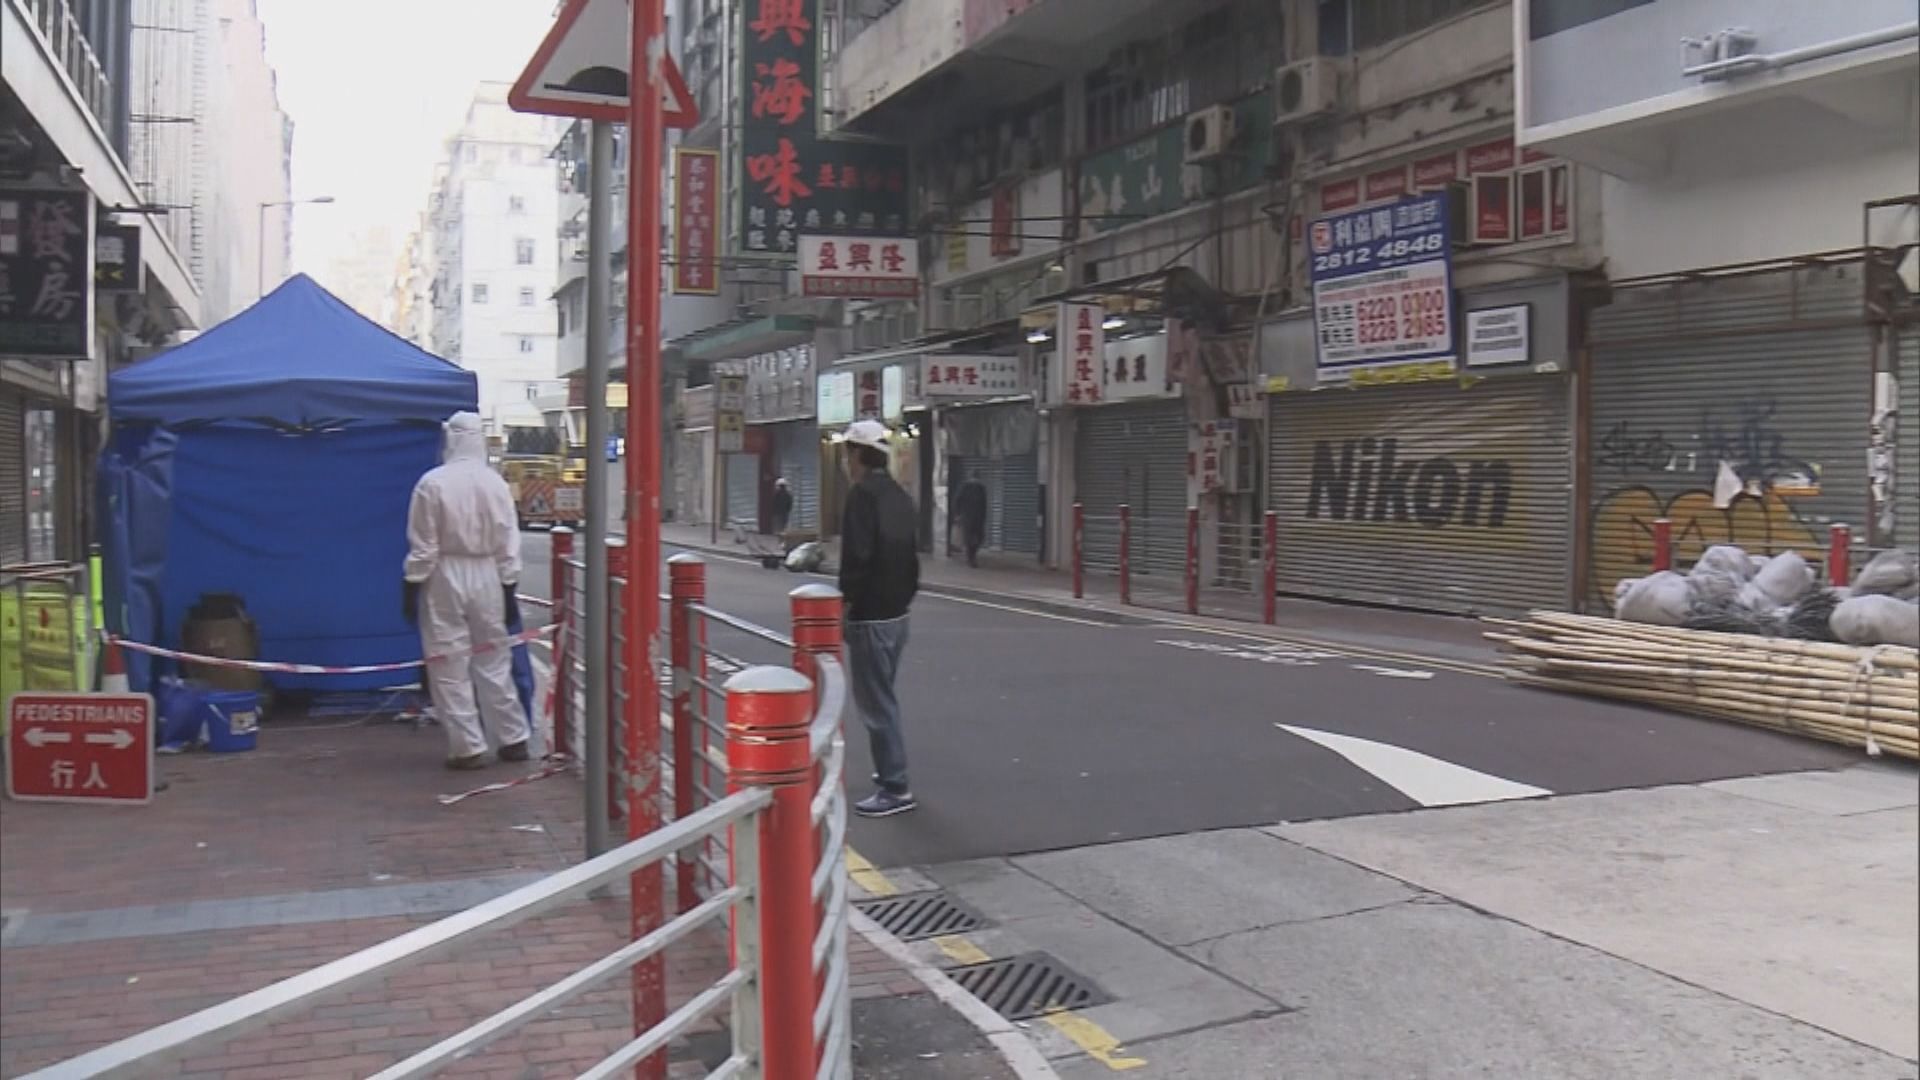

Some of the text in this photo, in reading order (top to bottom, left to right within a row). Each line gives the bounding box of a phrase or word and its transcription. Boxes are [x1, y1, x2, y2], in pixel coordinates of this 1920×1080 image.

[818, 241, 906, 271] 盈興隆
[1314, 248, 1371, 271] 2812
[1376, 234, 1443, 258] 4848
[1076, 308, 1094, 381] 盈興隆
[1307, 437, 1512, 529] Nikon
[15, 704, 144, 724] PEDESTRIANS
[51, 760, 108, 789] 行人
